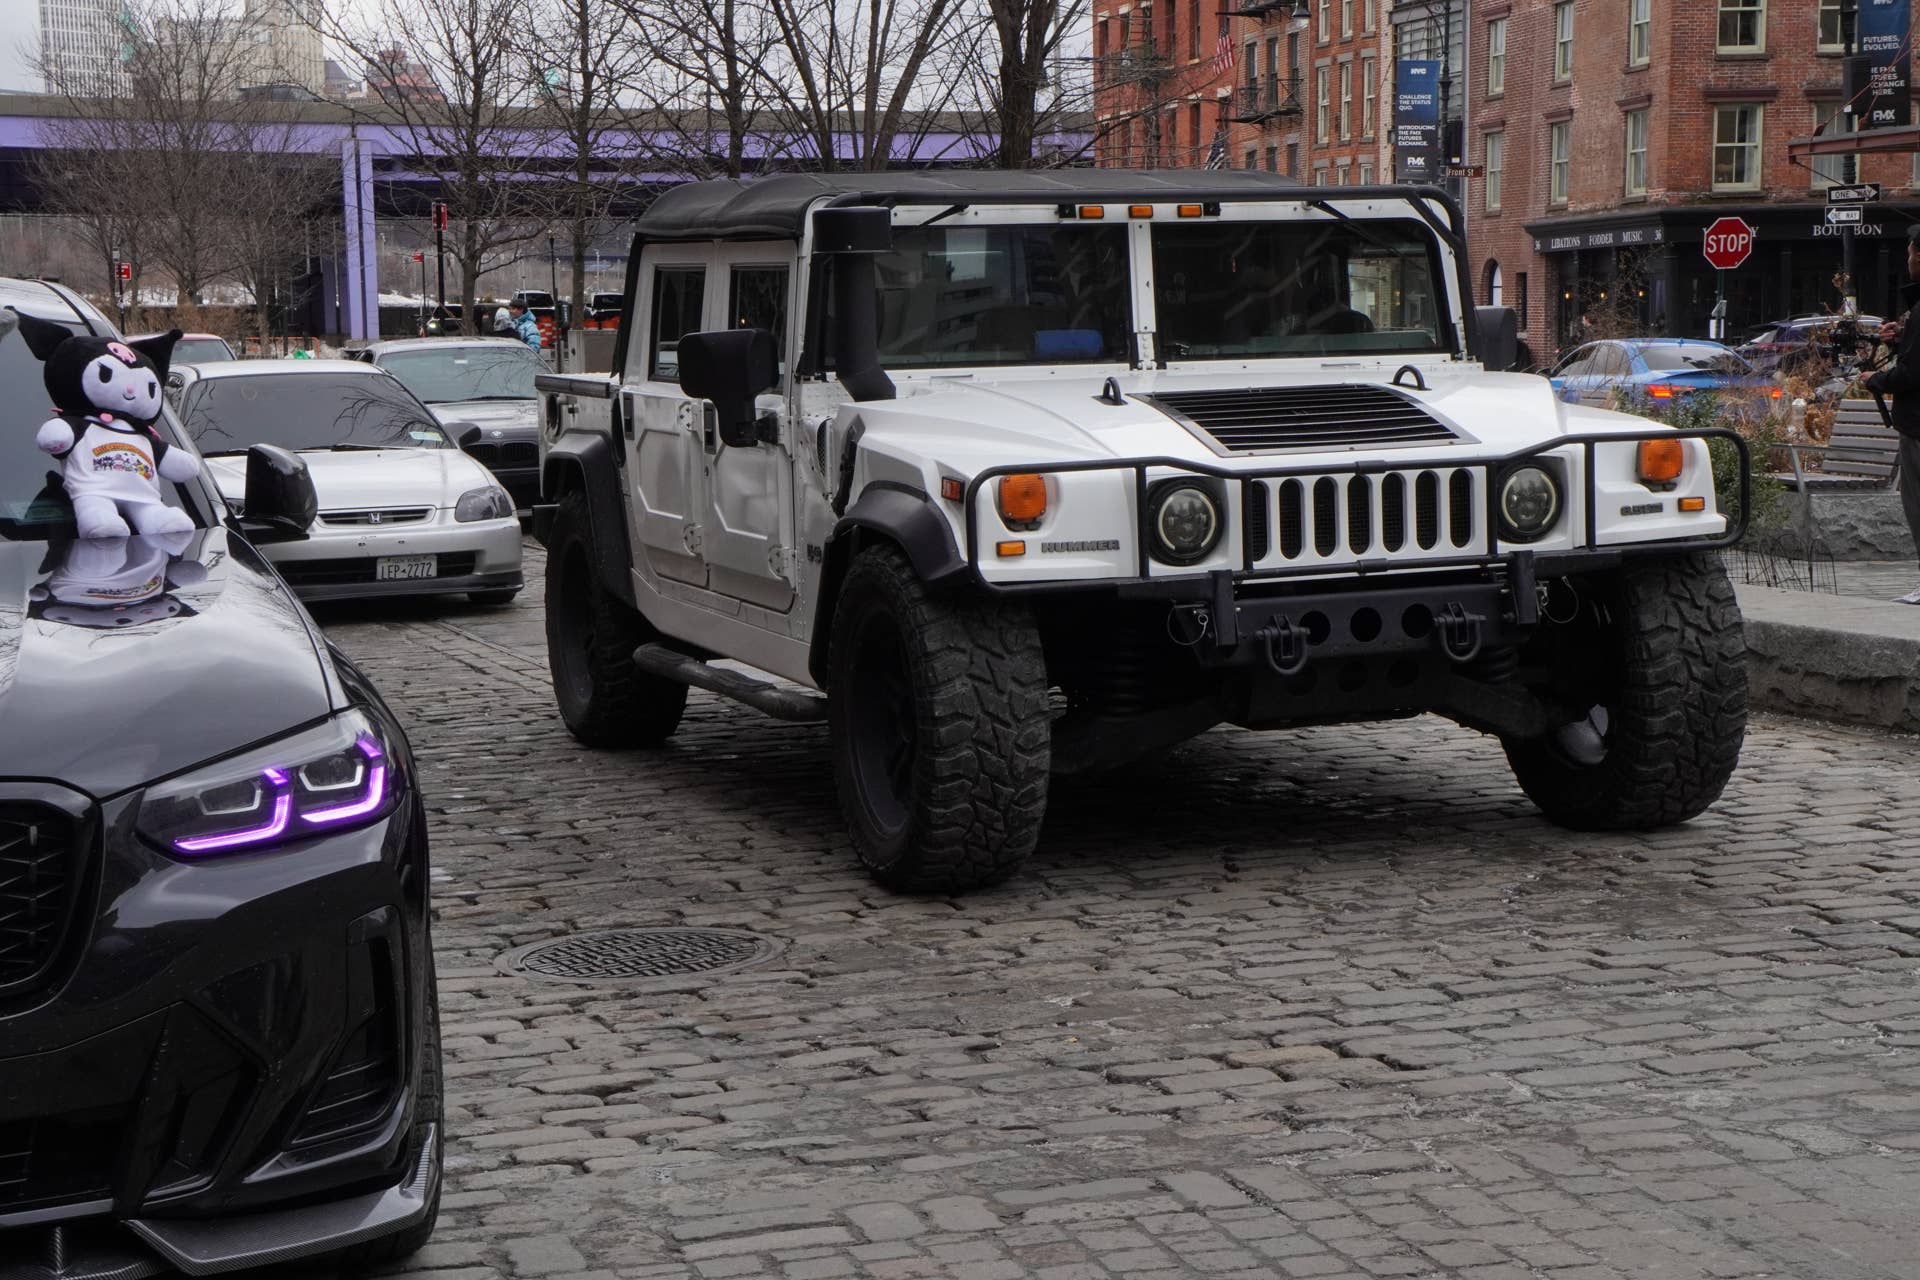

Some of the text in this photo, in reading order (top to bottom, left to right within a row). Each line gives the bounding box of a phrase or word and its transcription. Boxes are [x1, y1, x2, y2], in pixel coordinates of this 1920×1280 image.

[1863, 35, 1900, 43] FUTURES.
[1863, 43, 1900, 51] EVOLVED.
[1871, 80, 1905, 88] CHANGE
[1873, 109, 1895, 120] FMX
[1407, 156, 1425, 166] FMX
[1448, 168, 1474, 177] Front St
[1834, 190, 1850, 199] ONE
[1846, 211, 1858, 219] WAY
[1813, 224, 1883, 236] BOUBON
[1551, 236, 1581, 249] LIBATIONS
[1589, 232, 1613, 246] FODDER
[1622, 230, 1643, 243] MUSIC
[1707, 233, 1749, 253] STOP
[1041, 539, 1120, 553] HUMMER
